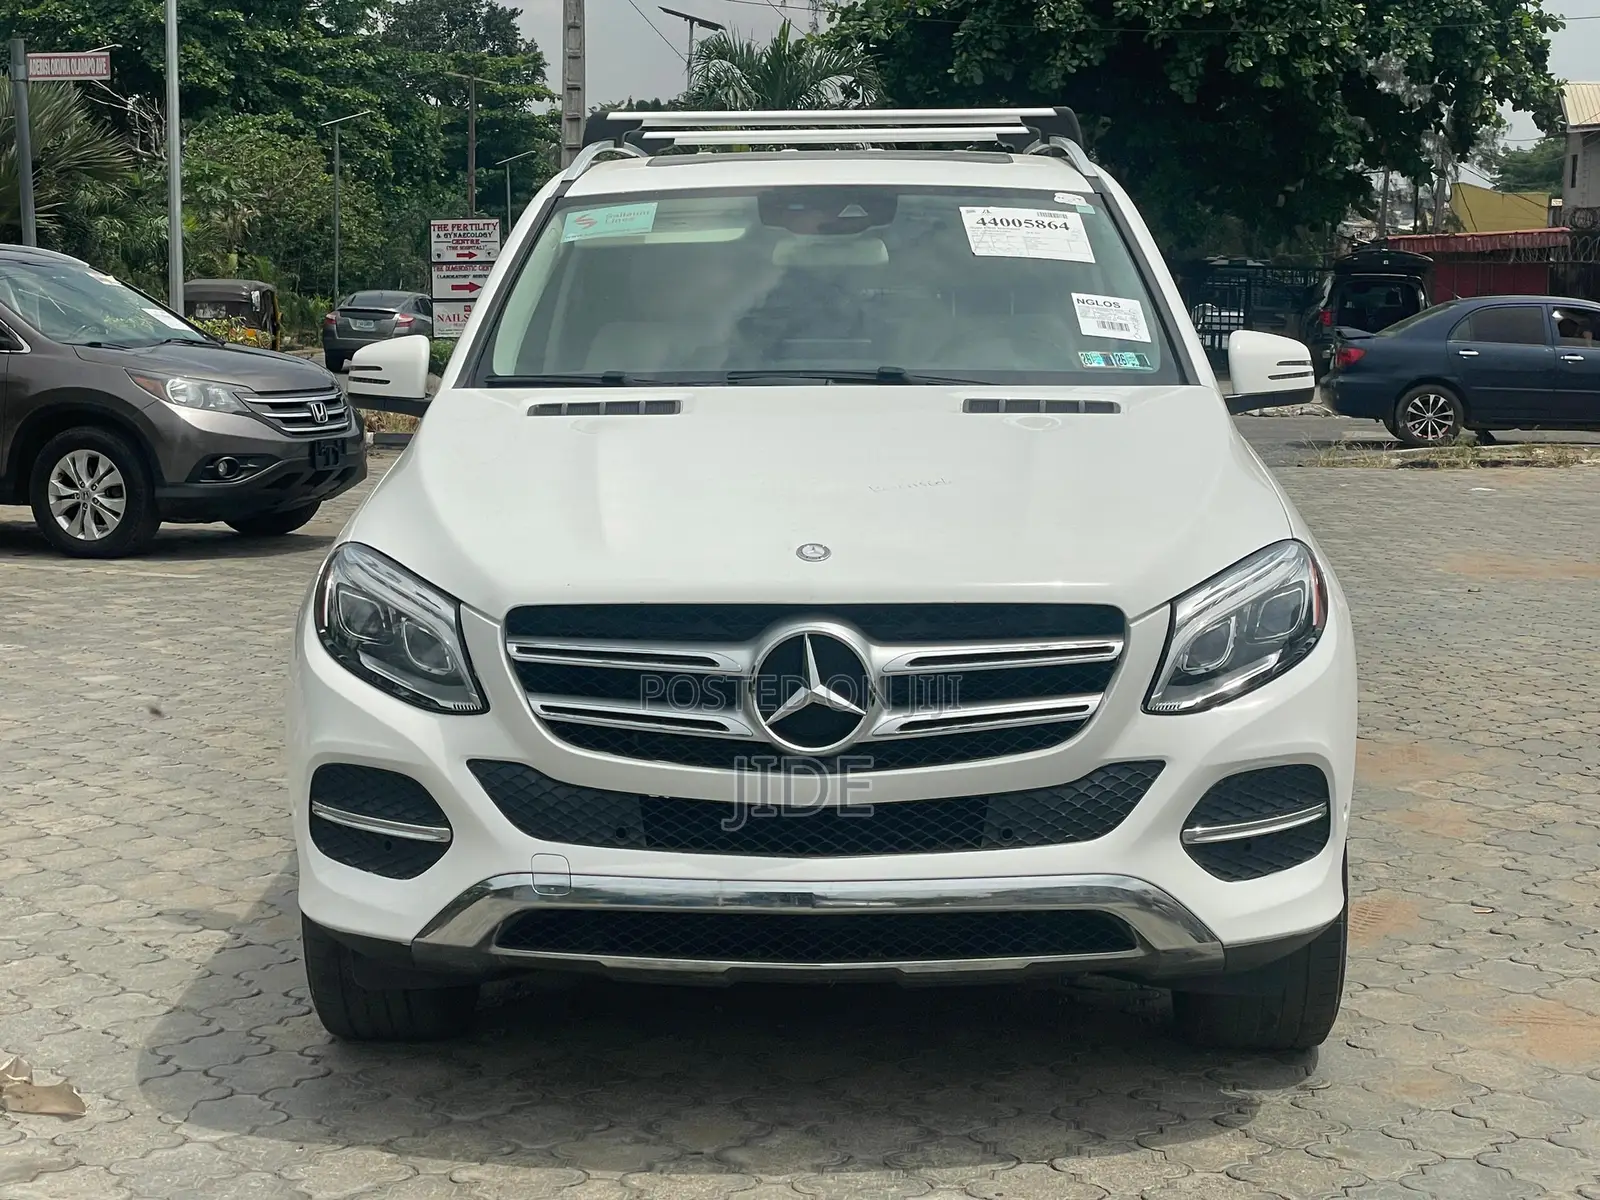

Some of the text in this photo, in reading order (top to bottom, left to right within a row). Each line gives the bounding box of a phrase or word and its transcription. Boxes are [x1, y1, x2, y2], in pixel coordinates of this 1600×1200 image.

[96, 57, 107, 74] AVE
[431, 222, 499, 232] THE FERTILITY
[976, 217, 1070, 231] 44005864
[443, 231, 493, 239] GYNAECOLOGY
[1076, 298, 1121, 309] NGLOS
